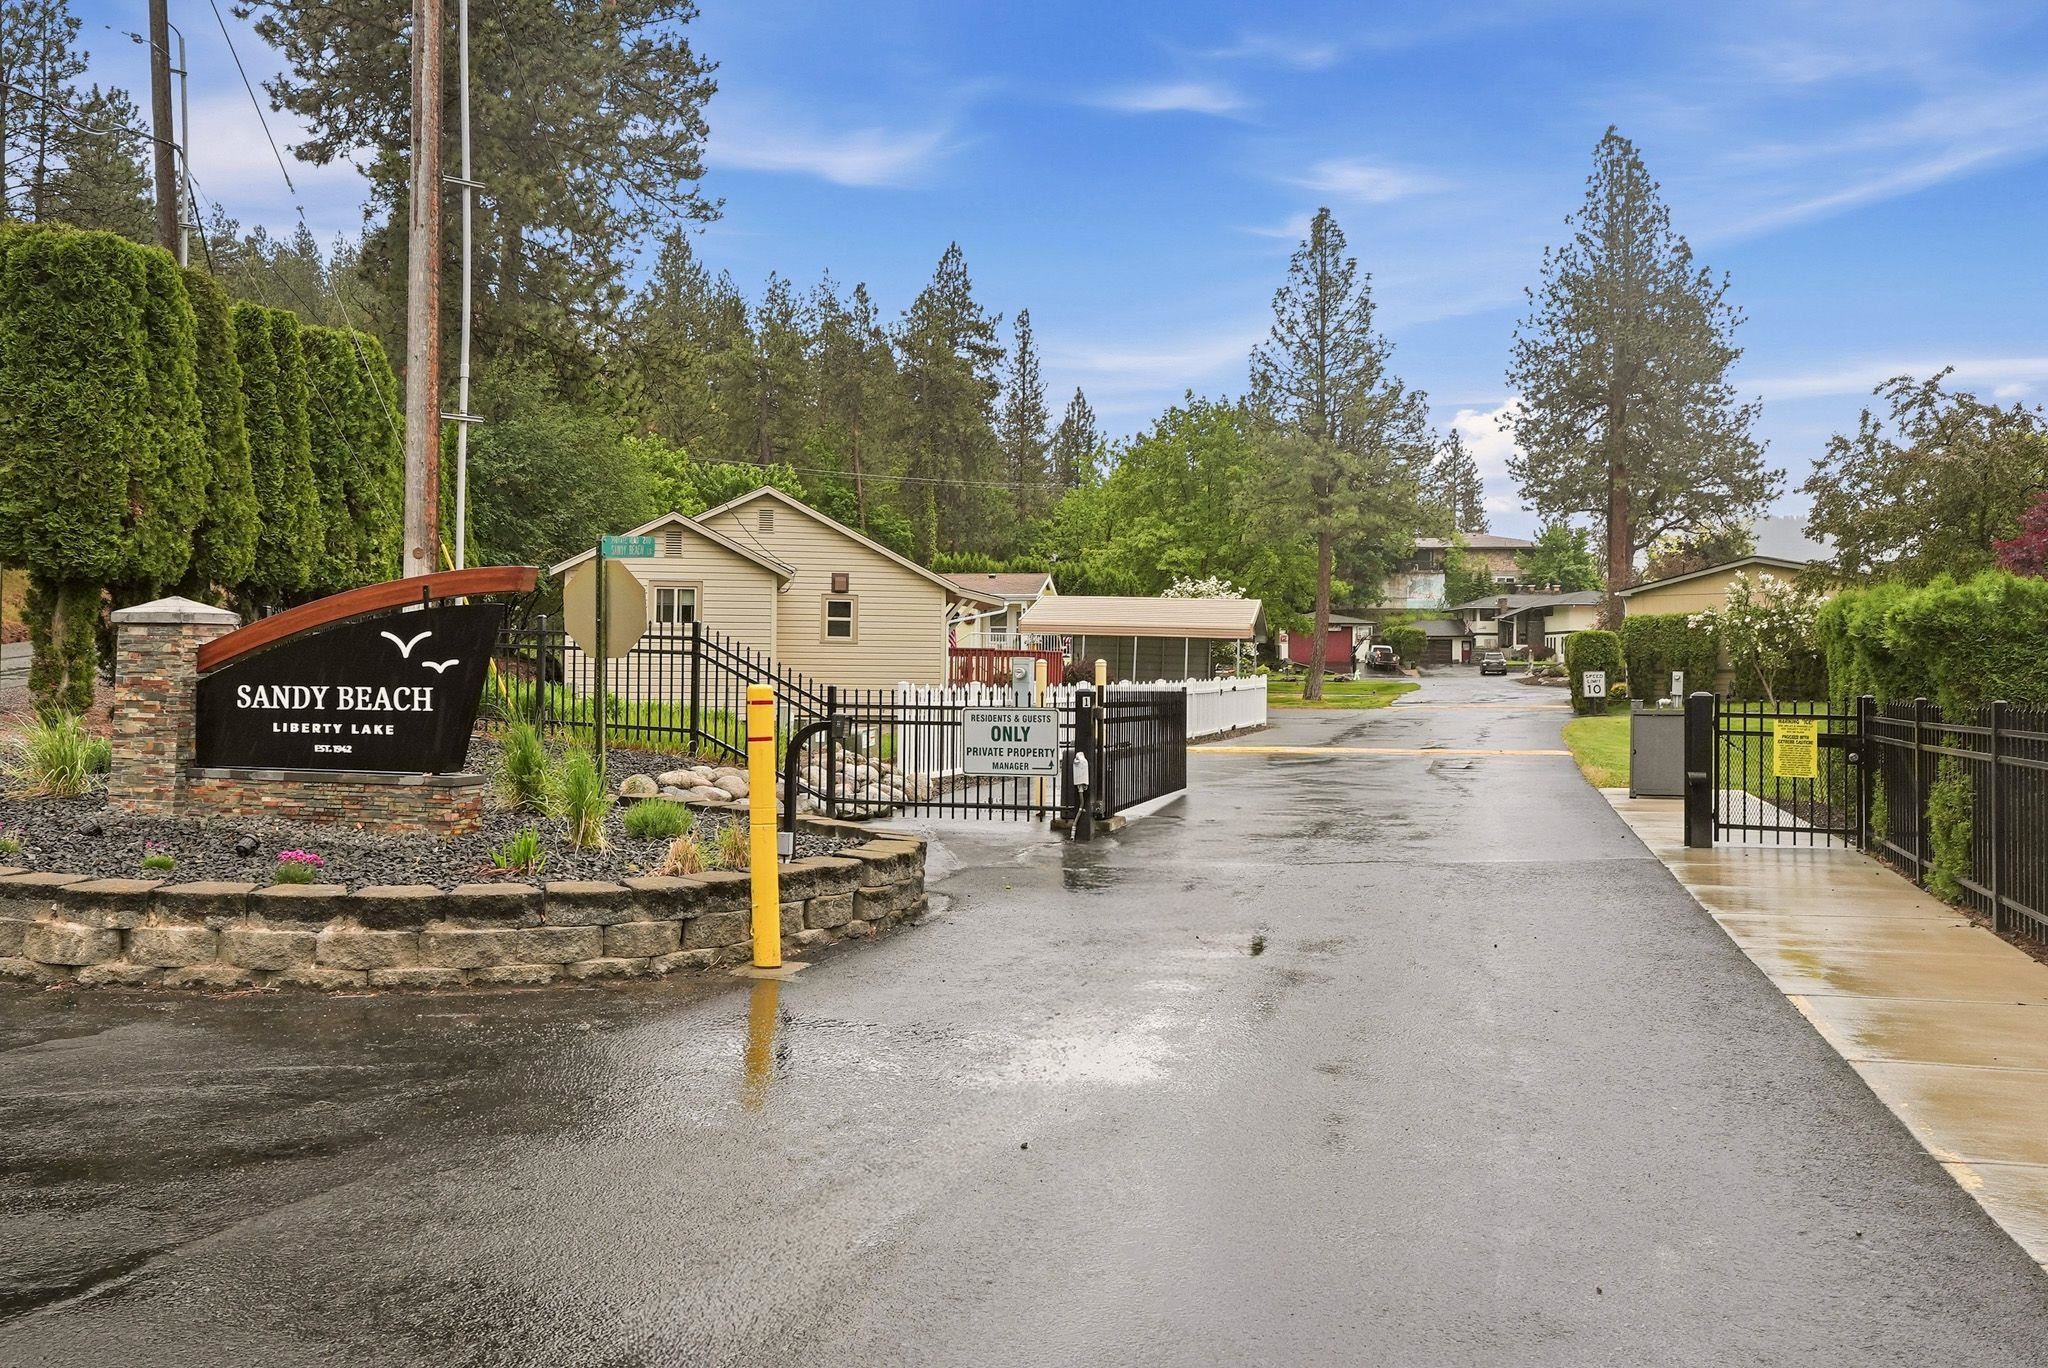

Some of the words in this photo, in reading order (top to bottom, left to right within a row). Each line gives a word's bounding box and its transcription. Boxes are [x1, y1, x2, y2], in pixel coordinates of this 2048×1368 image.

[1587, 684, 1602, 694] 10
[237, 685, 330, 710] SANDY
[336, 686, 434, 712] BEACH
[970, 714, 1012, 723] RESIDENTS
[1013, 714, 1020, 723] &
[1022, 714, 1051, 723] GUESTS
[273, 722, 342, 735] LIBERTY
[351, 723, 395, 736] LAKE
[990, 725, 1031, 742] ONLY
[314, 744, 332, 753] EST.
[966, 747, 1004, 757] PRIVATE
[1007, 747, 1056, 758] PROPERTY
[992, 762, 1029, 770] MANAGER
